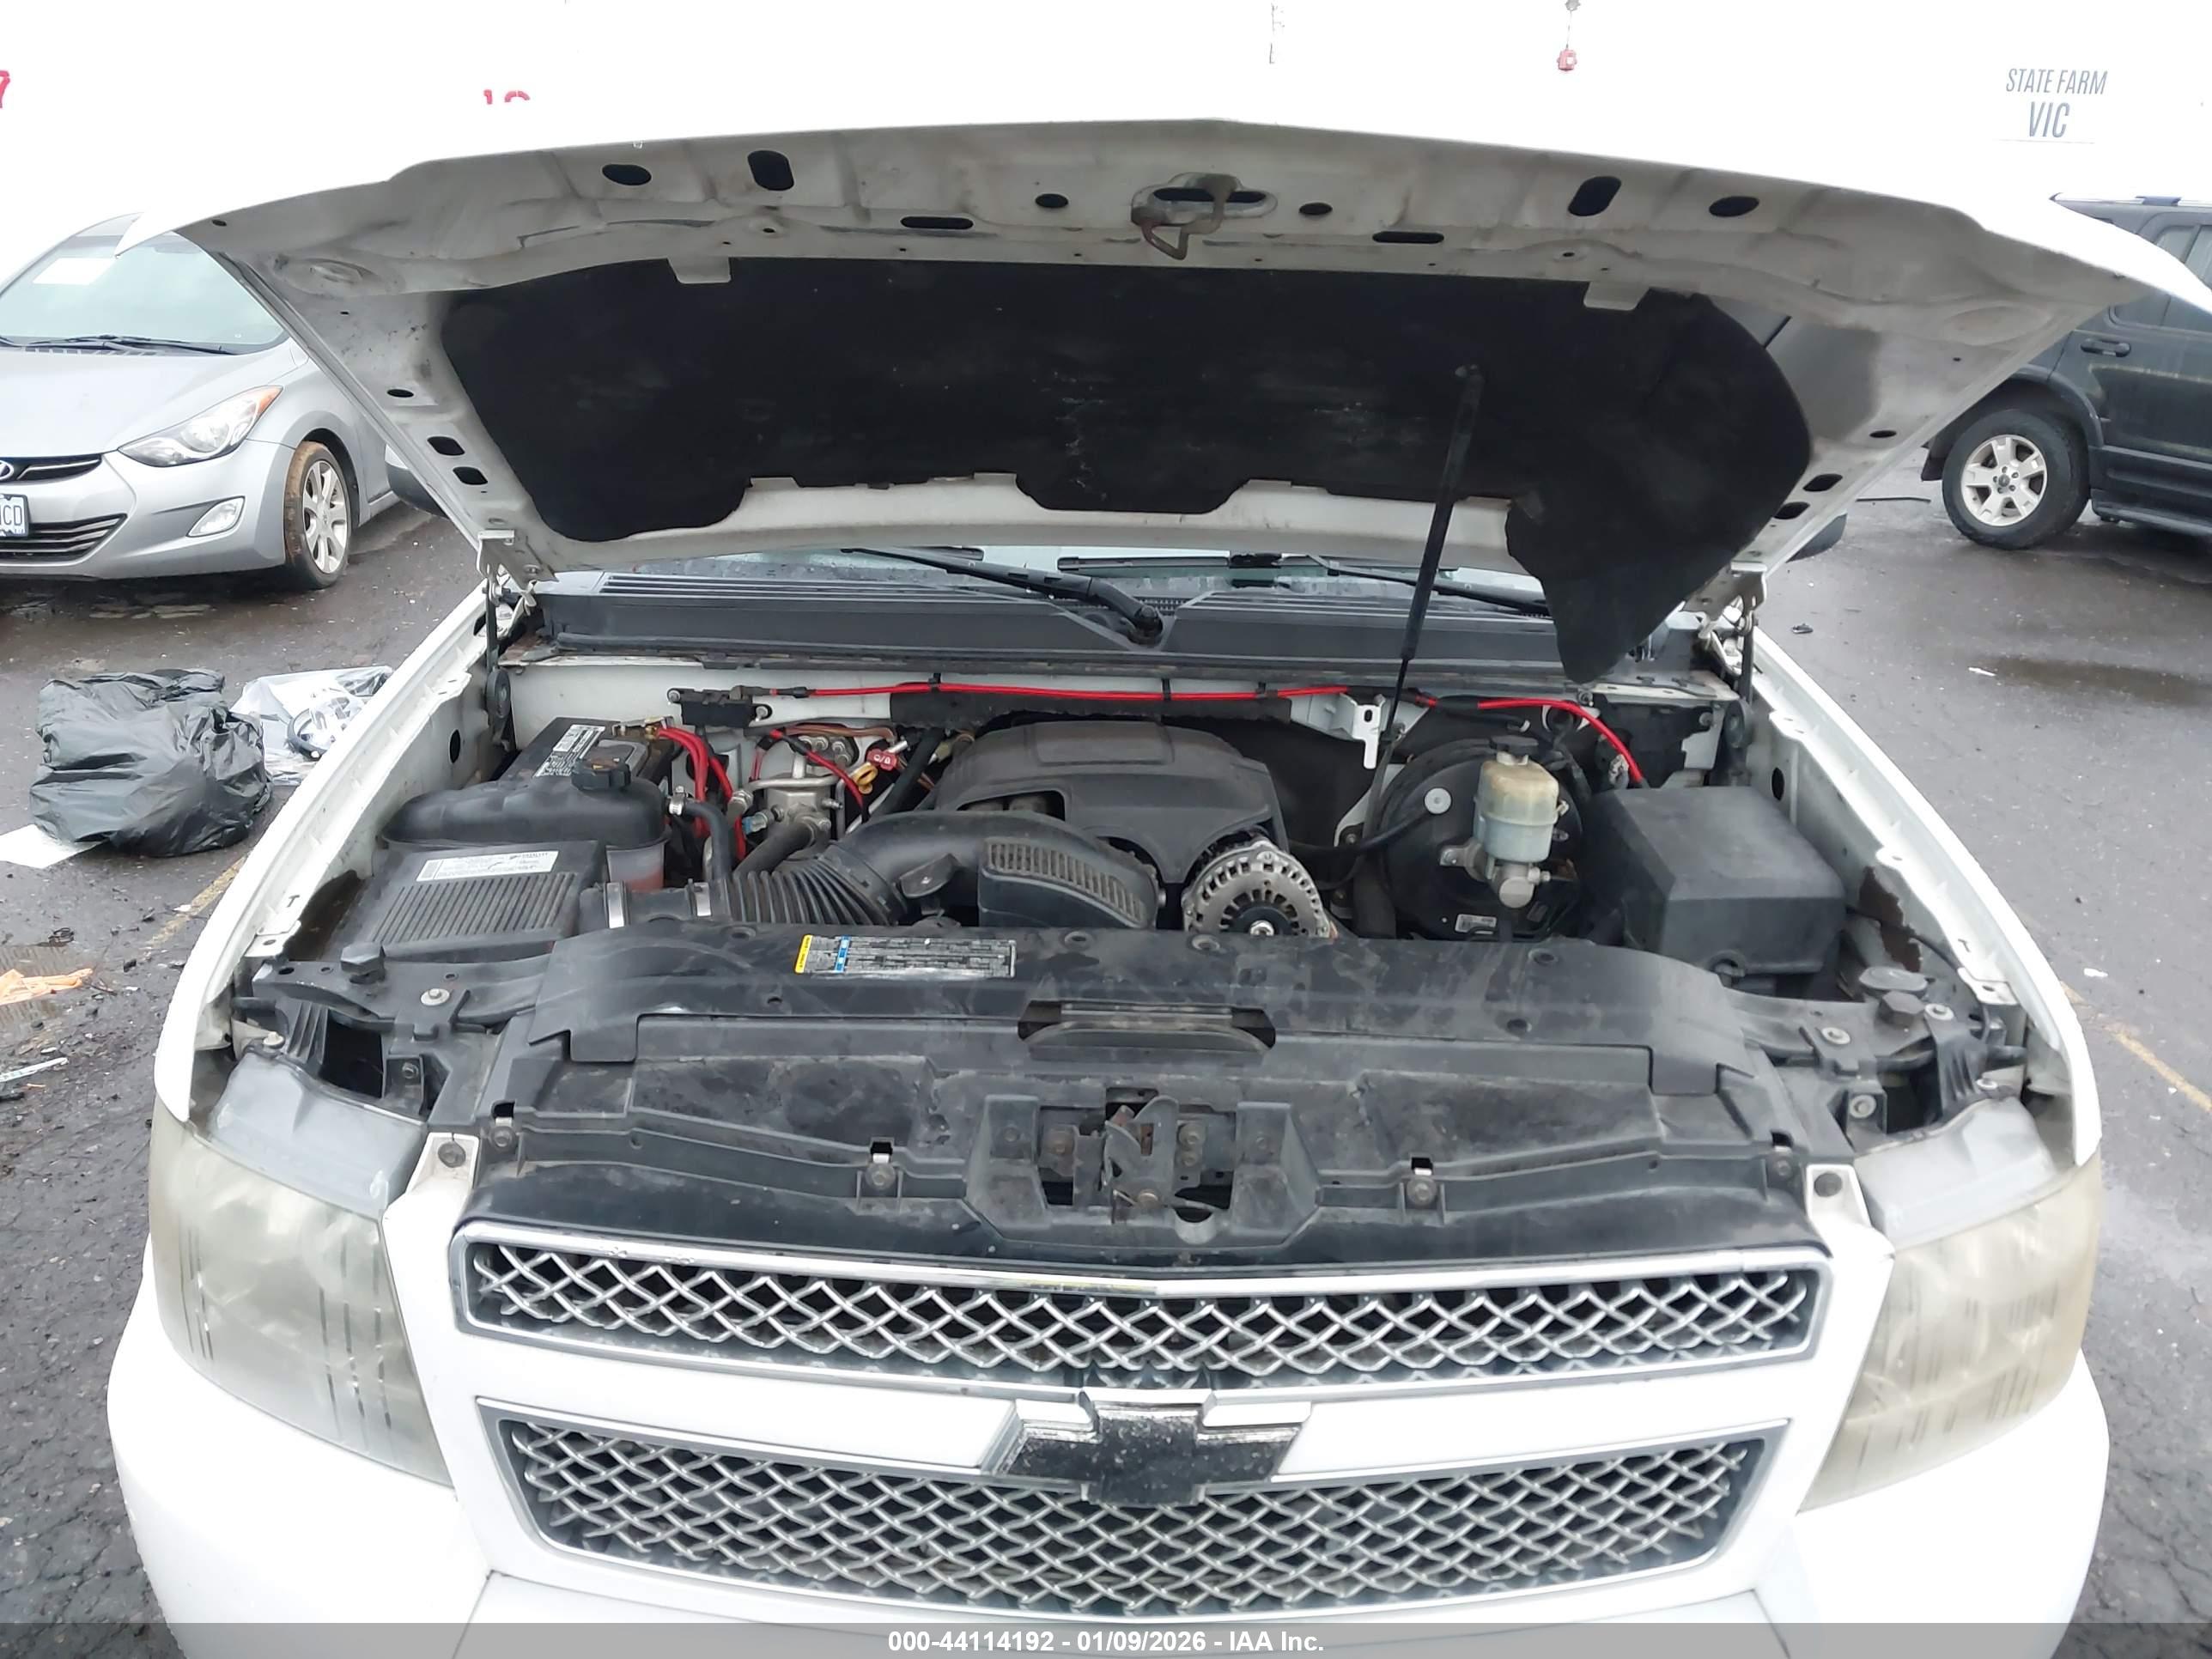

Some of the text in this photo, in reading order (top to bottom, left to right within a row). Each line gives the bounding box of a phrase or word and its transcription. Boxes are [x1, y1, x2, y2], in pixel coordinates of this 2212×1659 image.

[2006, 67, 2108, 95] STATE FARM
[2028, 101, 2070, 138] VIC
[0, 505, 22, 526] CD
